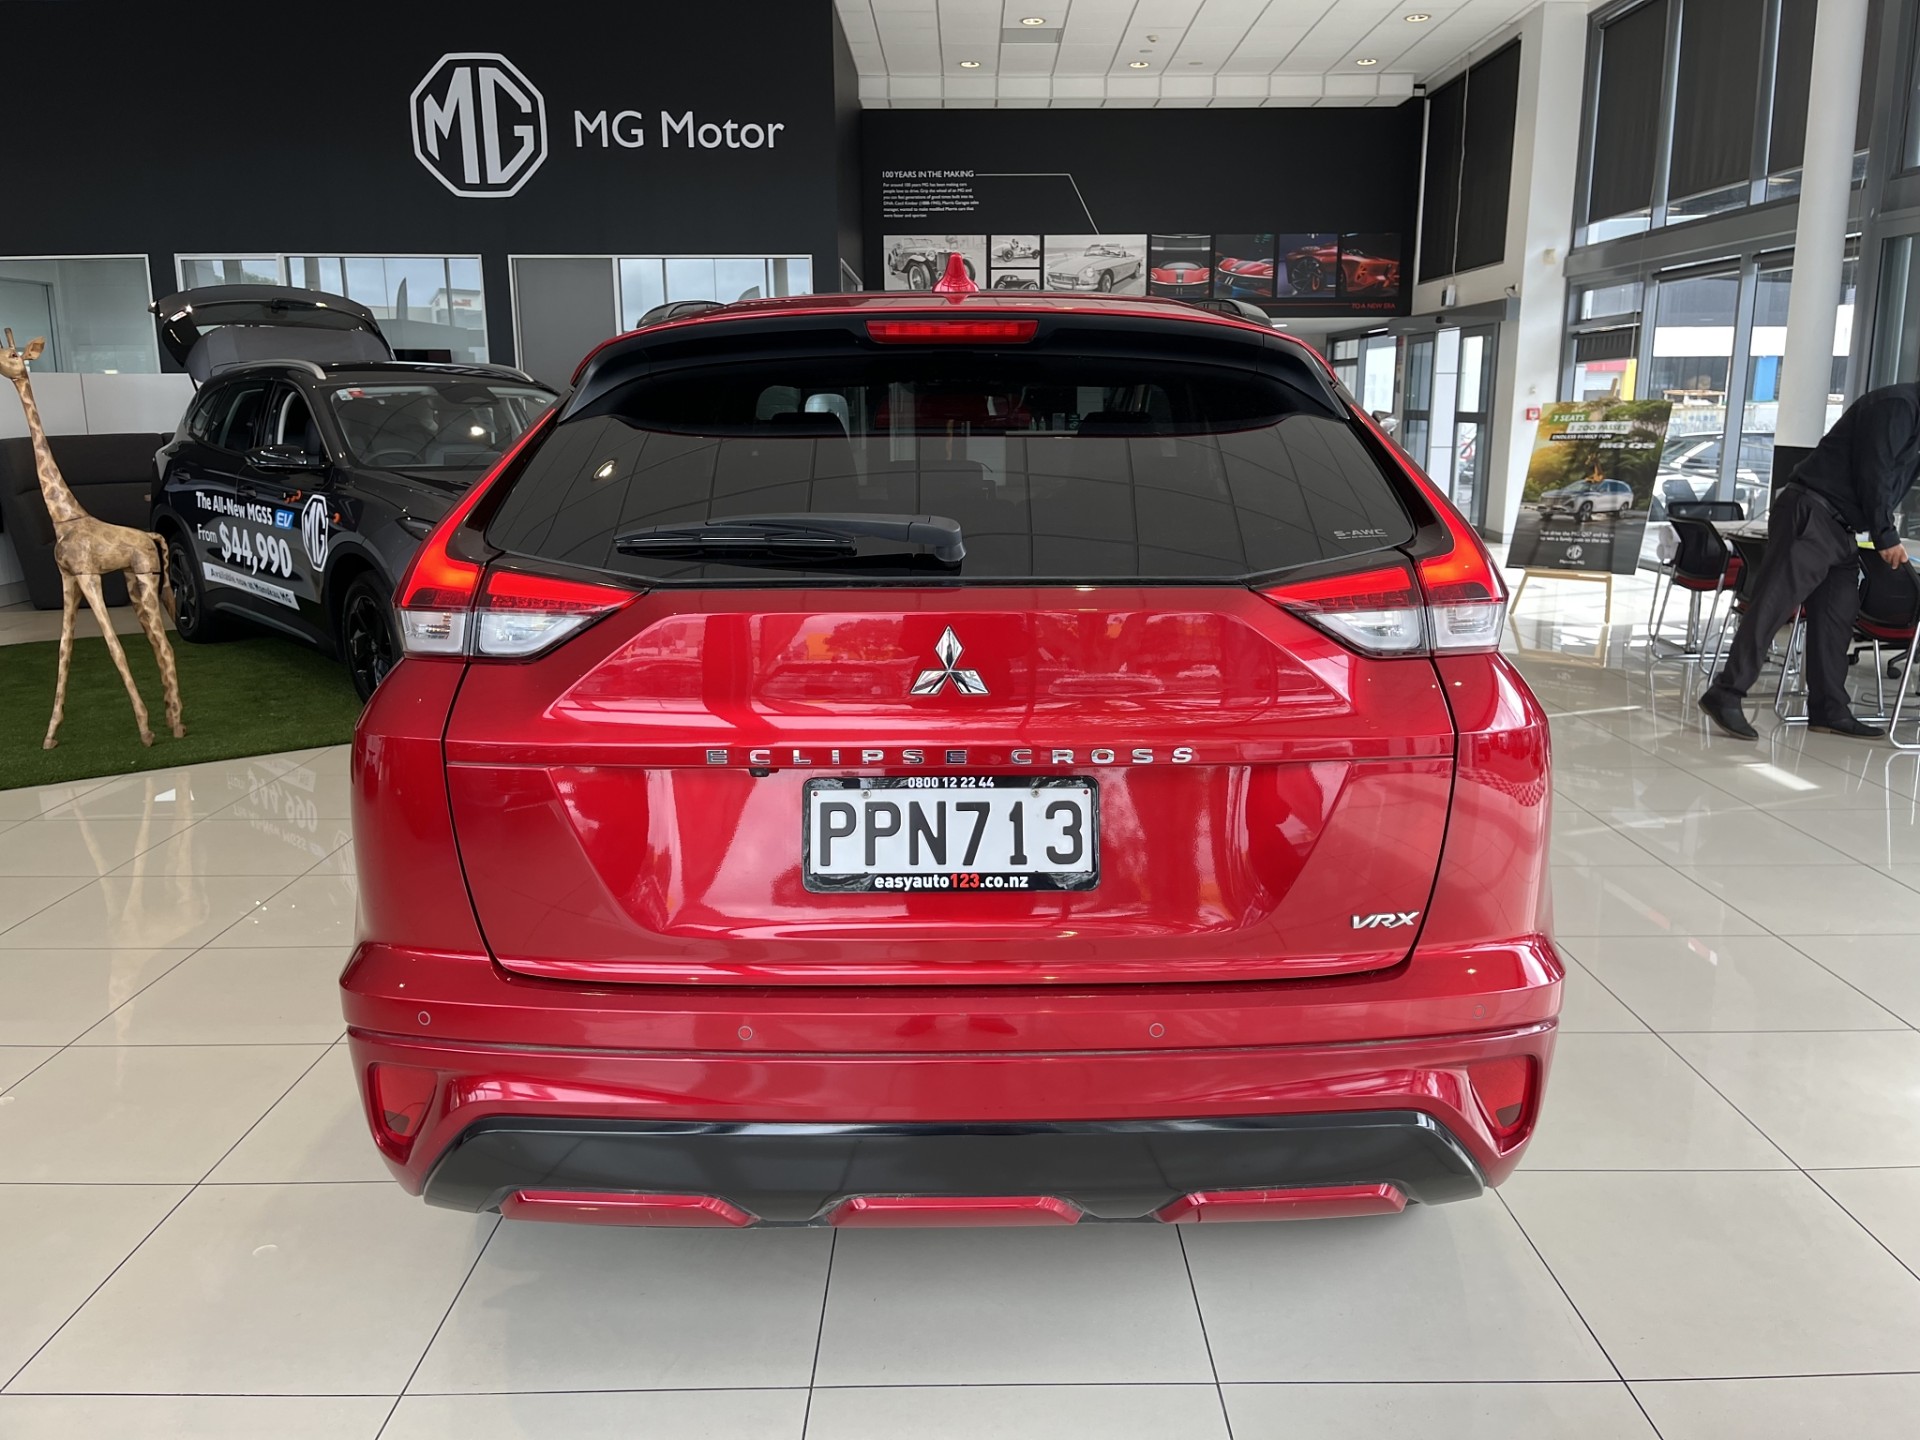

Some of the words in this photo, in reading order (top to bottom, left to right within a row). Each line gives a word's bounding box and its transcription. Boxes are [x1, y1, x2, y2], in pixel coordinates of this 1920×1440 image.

[423, 66, 535, 185] MG
[574, 110, 645, 148] MG
[661, 110, 785, 148] Motor
[196, 491, 212, 510] The
[212, 495, 246, 518] All-New
[246, 503, 273, 526] MGS5
[276, 512, 292, 527] EV
[197, 524, 218, 543] From
[219, 521, 292, 578] $44,990
[304, 501, 326, 565] MG
[1334, 528, 1386, 536] S-AWC
[705, 749, 969, 765] ECLIPSE
[1011, 747, 1193, 764] CROSS
[908, 776, 939, 788] 0800
[942, 776, 957, 788] 12
[960, 776, 976, 788] 22
[978, 776, 994, 788] 44
[820, 800, 1083, 866] PPN713
[874, 873, 1029, 891] easyauto123.co.nz
[1352, 912, 1420, 929] VRX
